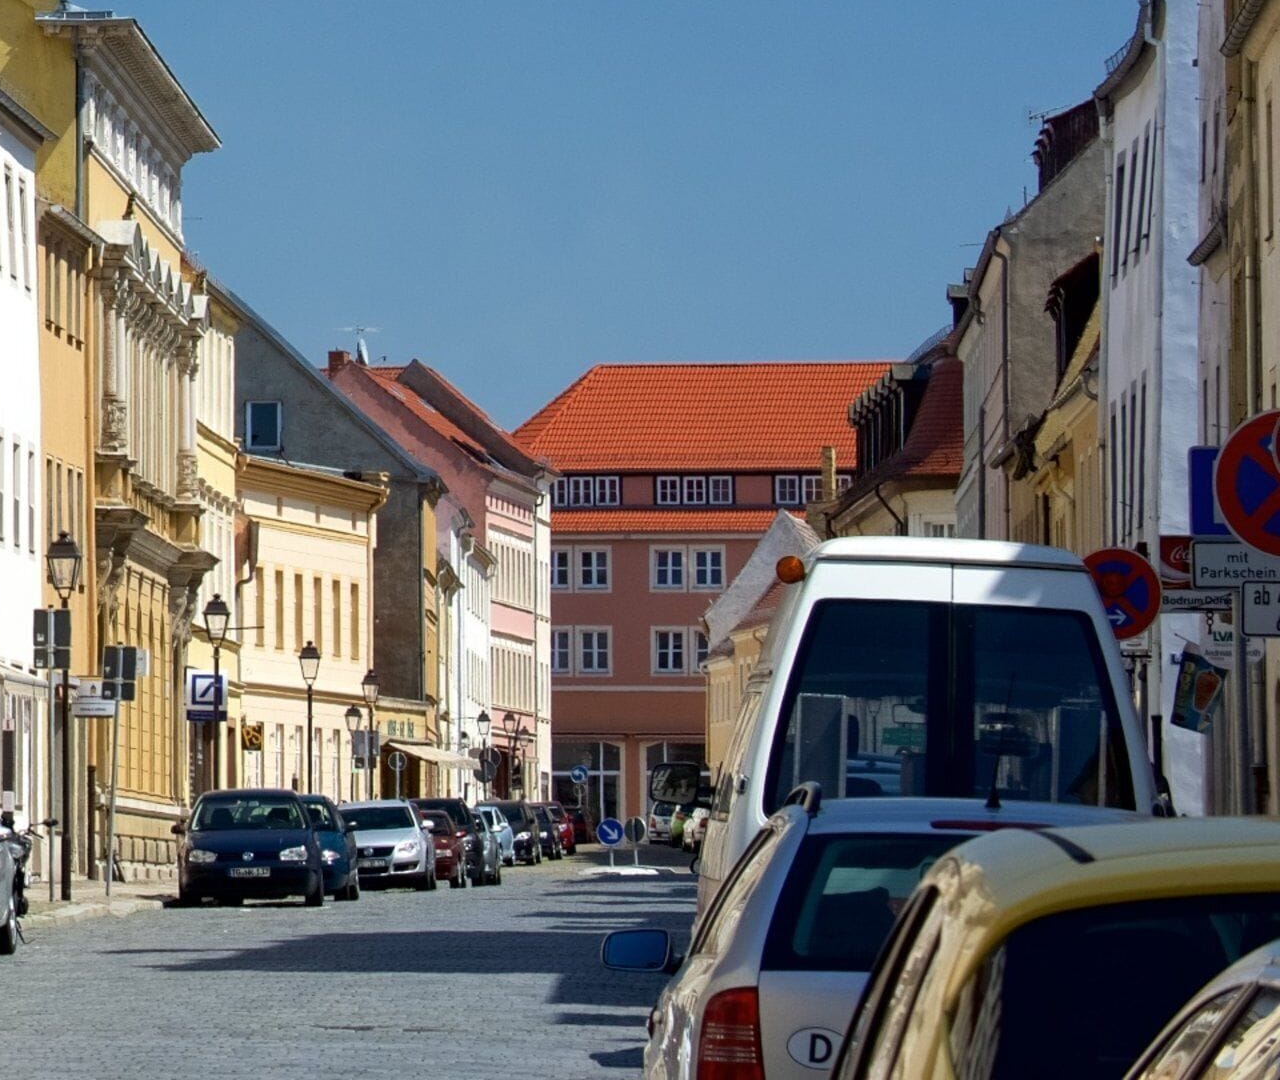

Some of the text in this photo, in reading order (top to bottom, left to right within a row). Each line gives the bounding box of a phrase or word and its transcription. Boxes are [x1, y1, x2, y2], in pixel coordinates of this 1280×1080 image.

[1227, 552, 1249, 563] mit
[1200, 566, 1277, 578] Parkschein
[1162, 595, 1203, 605] Bodrum
[1253, 585, 1271, 606] ab
[808, 1033, 833, 1063] D
